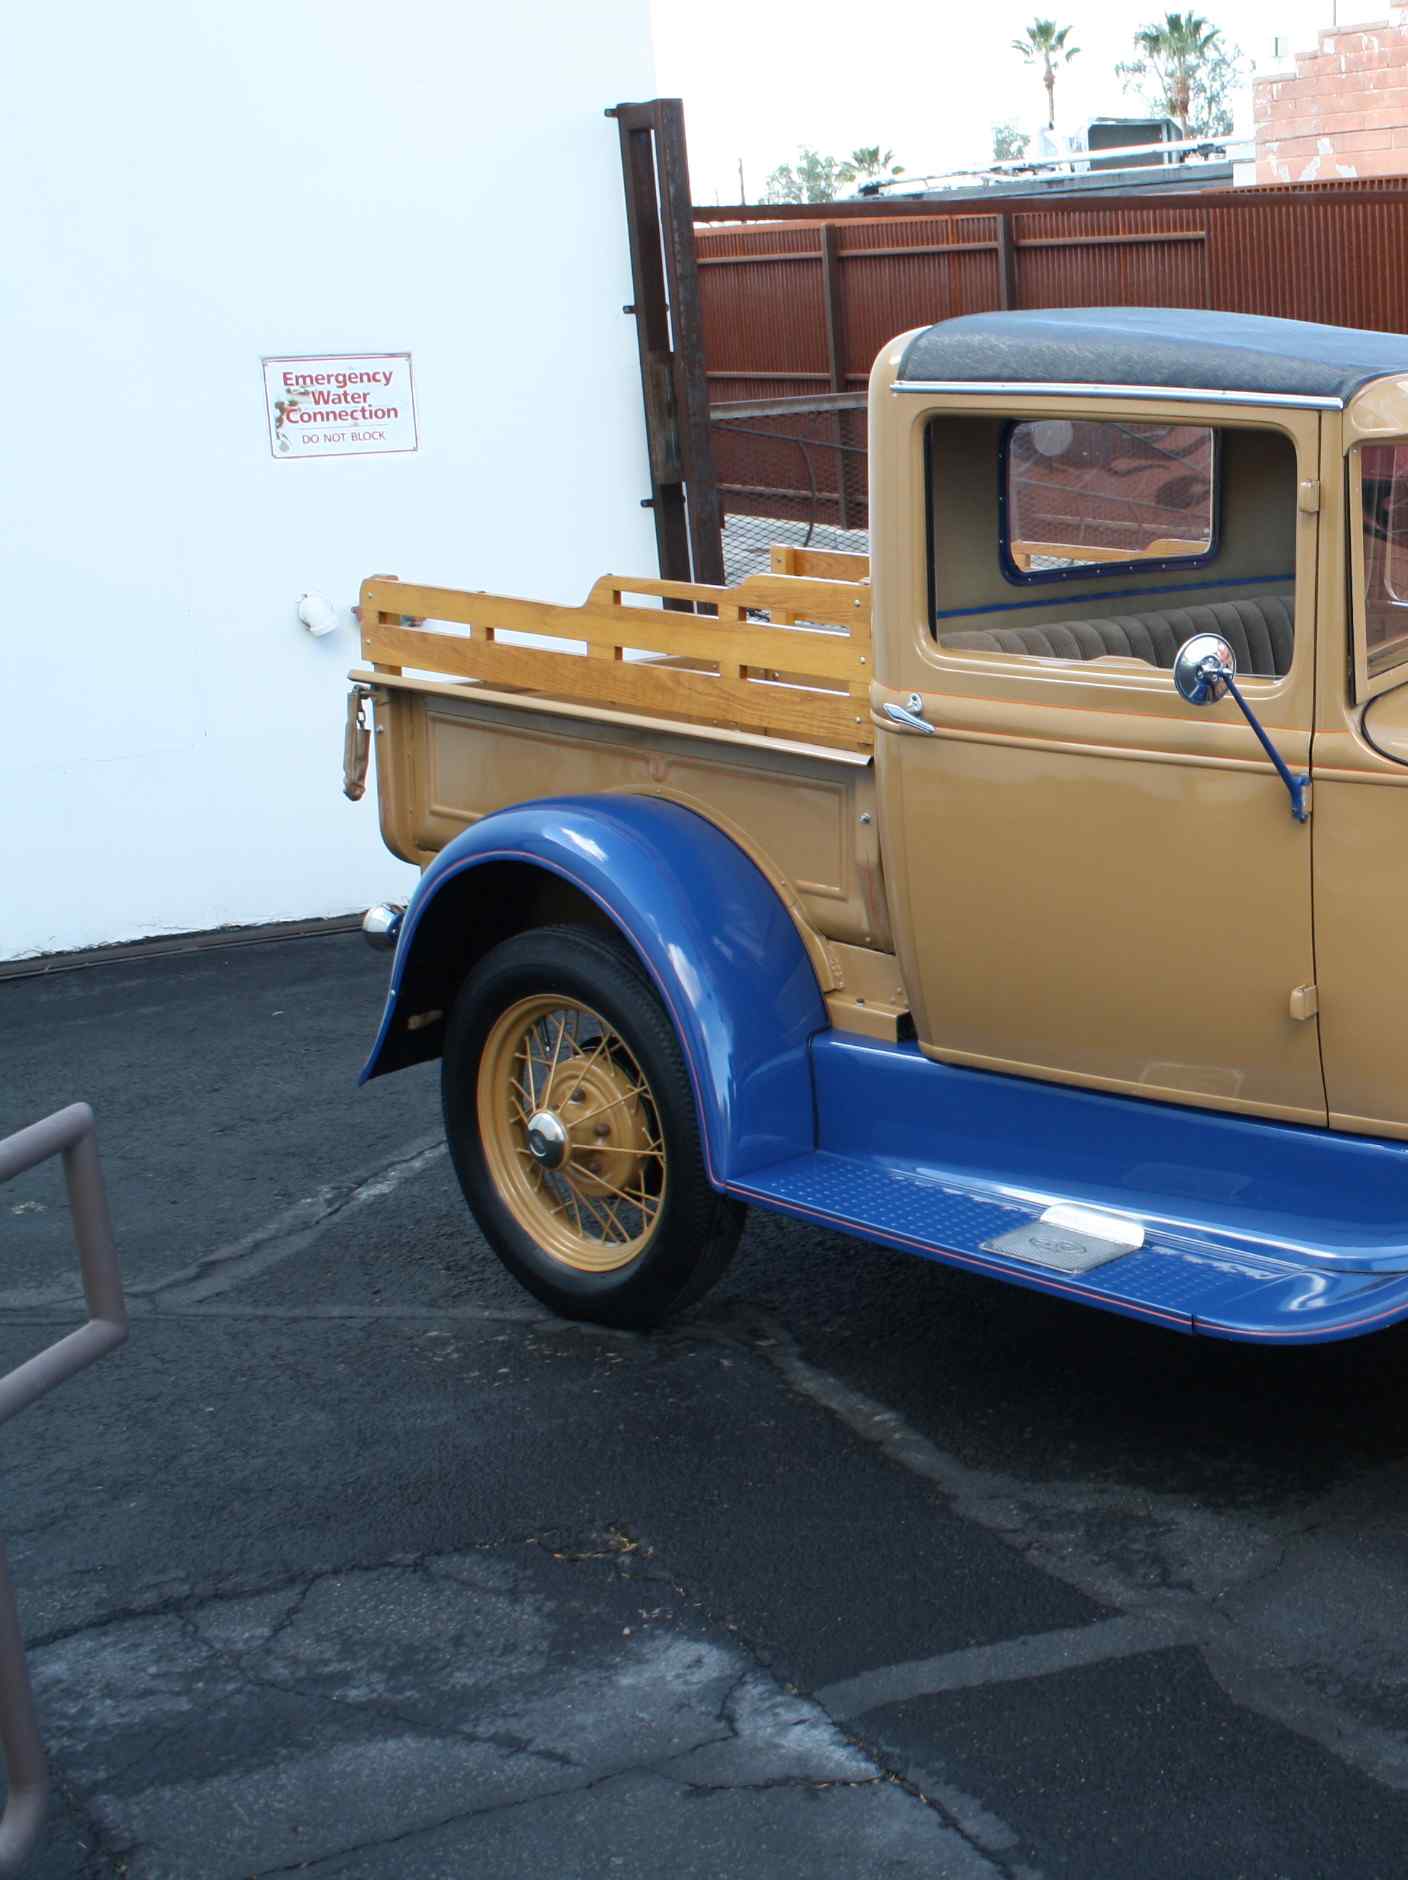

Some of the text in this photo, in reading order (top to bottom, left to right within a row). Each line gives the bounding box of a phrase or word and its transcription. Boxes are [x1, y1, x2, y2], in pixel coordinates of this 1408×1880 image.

[282, 370, 394, 388] Emergency
[311, 390, 370, 406] Water
[285, 404, 399, 424] Connection
[302, 431, 386, 445] DO NOT BLOCK
